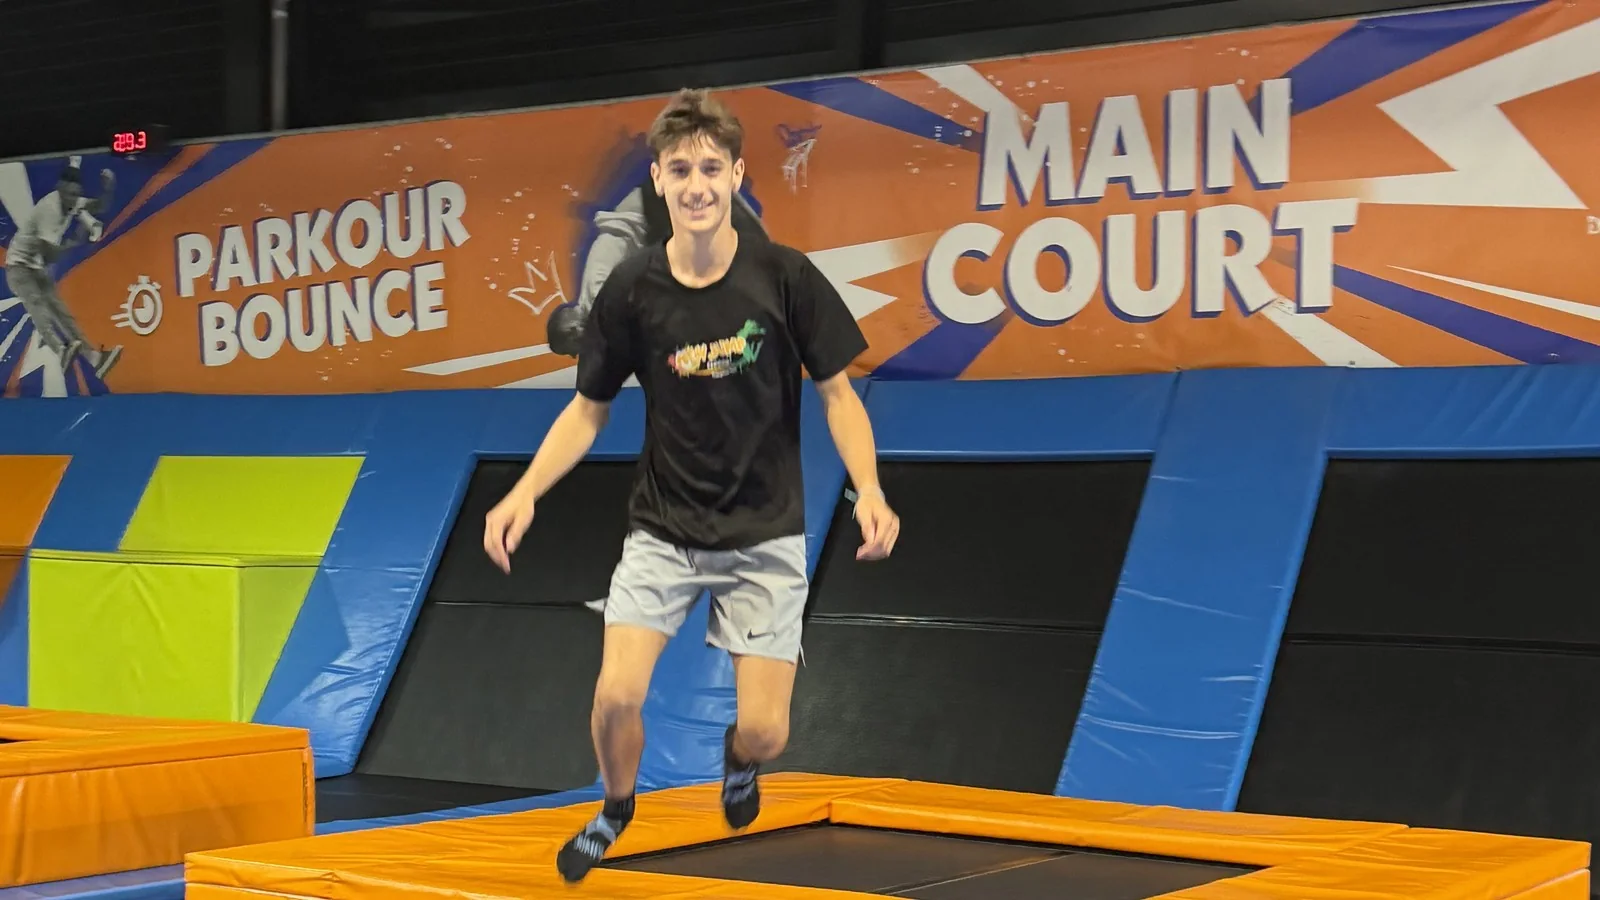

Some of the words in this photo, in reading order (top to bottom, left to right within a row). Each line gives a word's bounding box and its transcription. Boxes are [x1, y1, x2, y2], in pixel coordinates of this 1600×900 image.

[977, 77, 1292, 210] MAIN
[175, 179, 471, 298] PARKOUR
[923, 197, 1359, 328] COURT
[198, 261, 449, 367] BOUNCE
